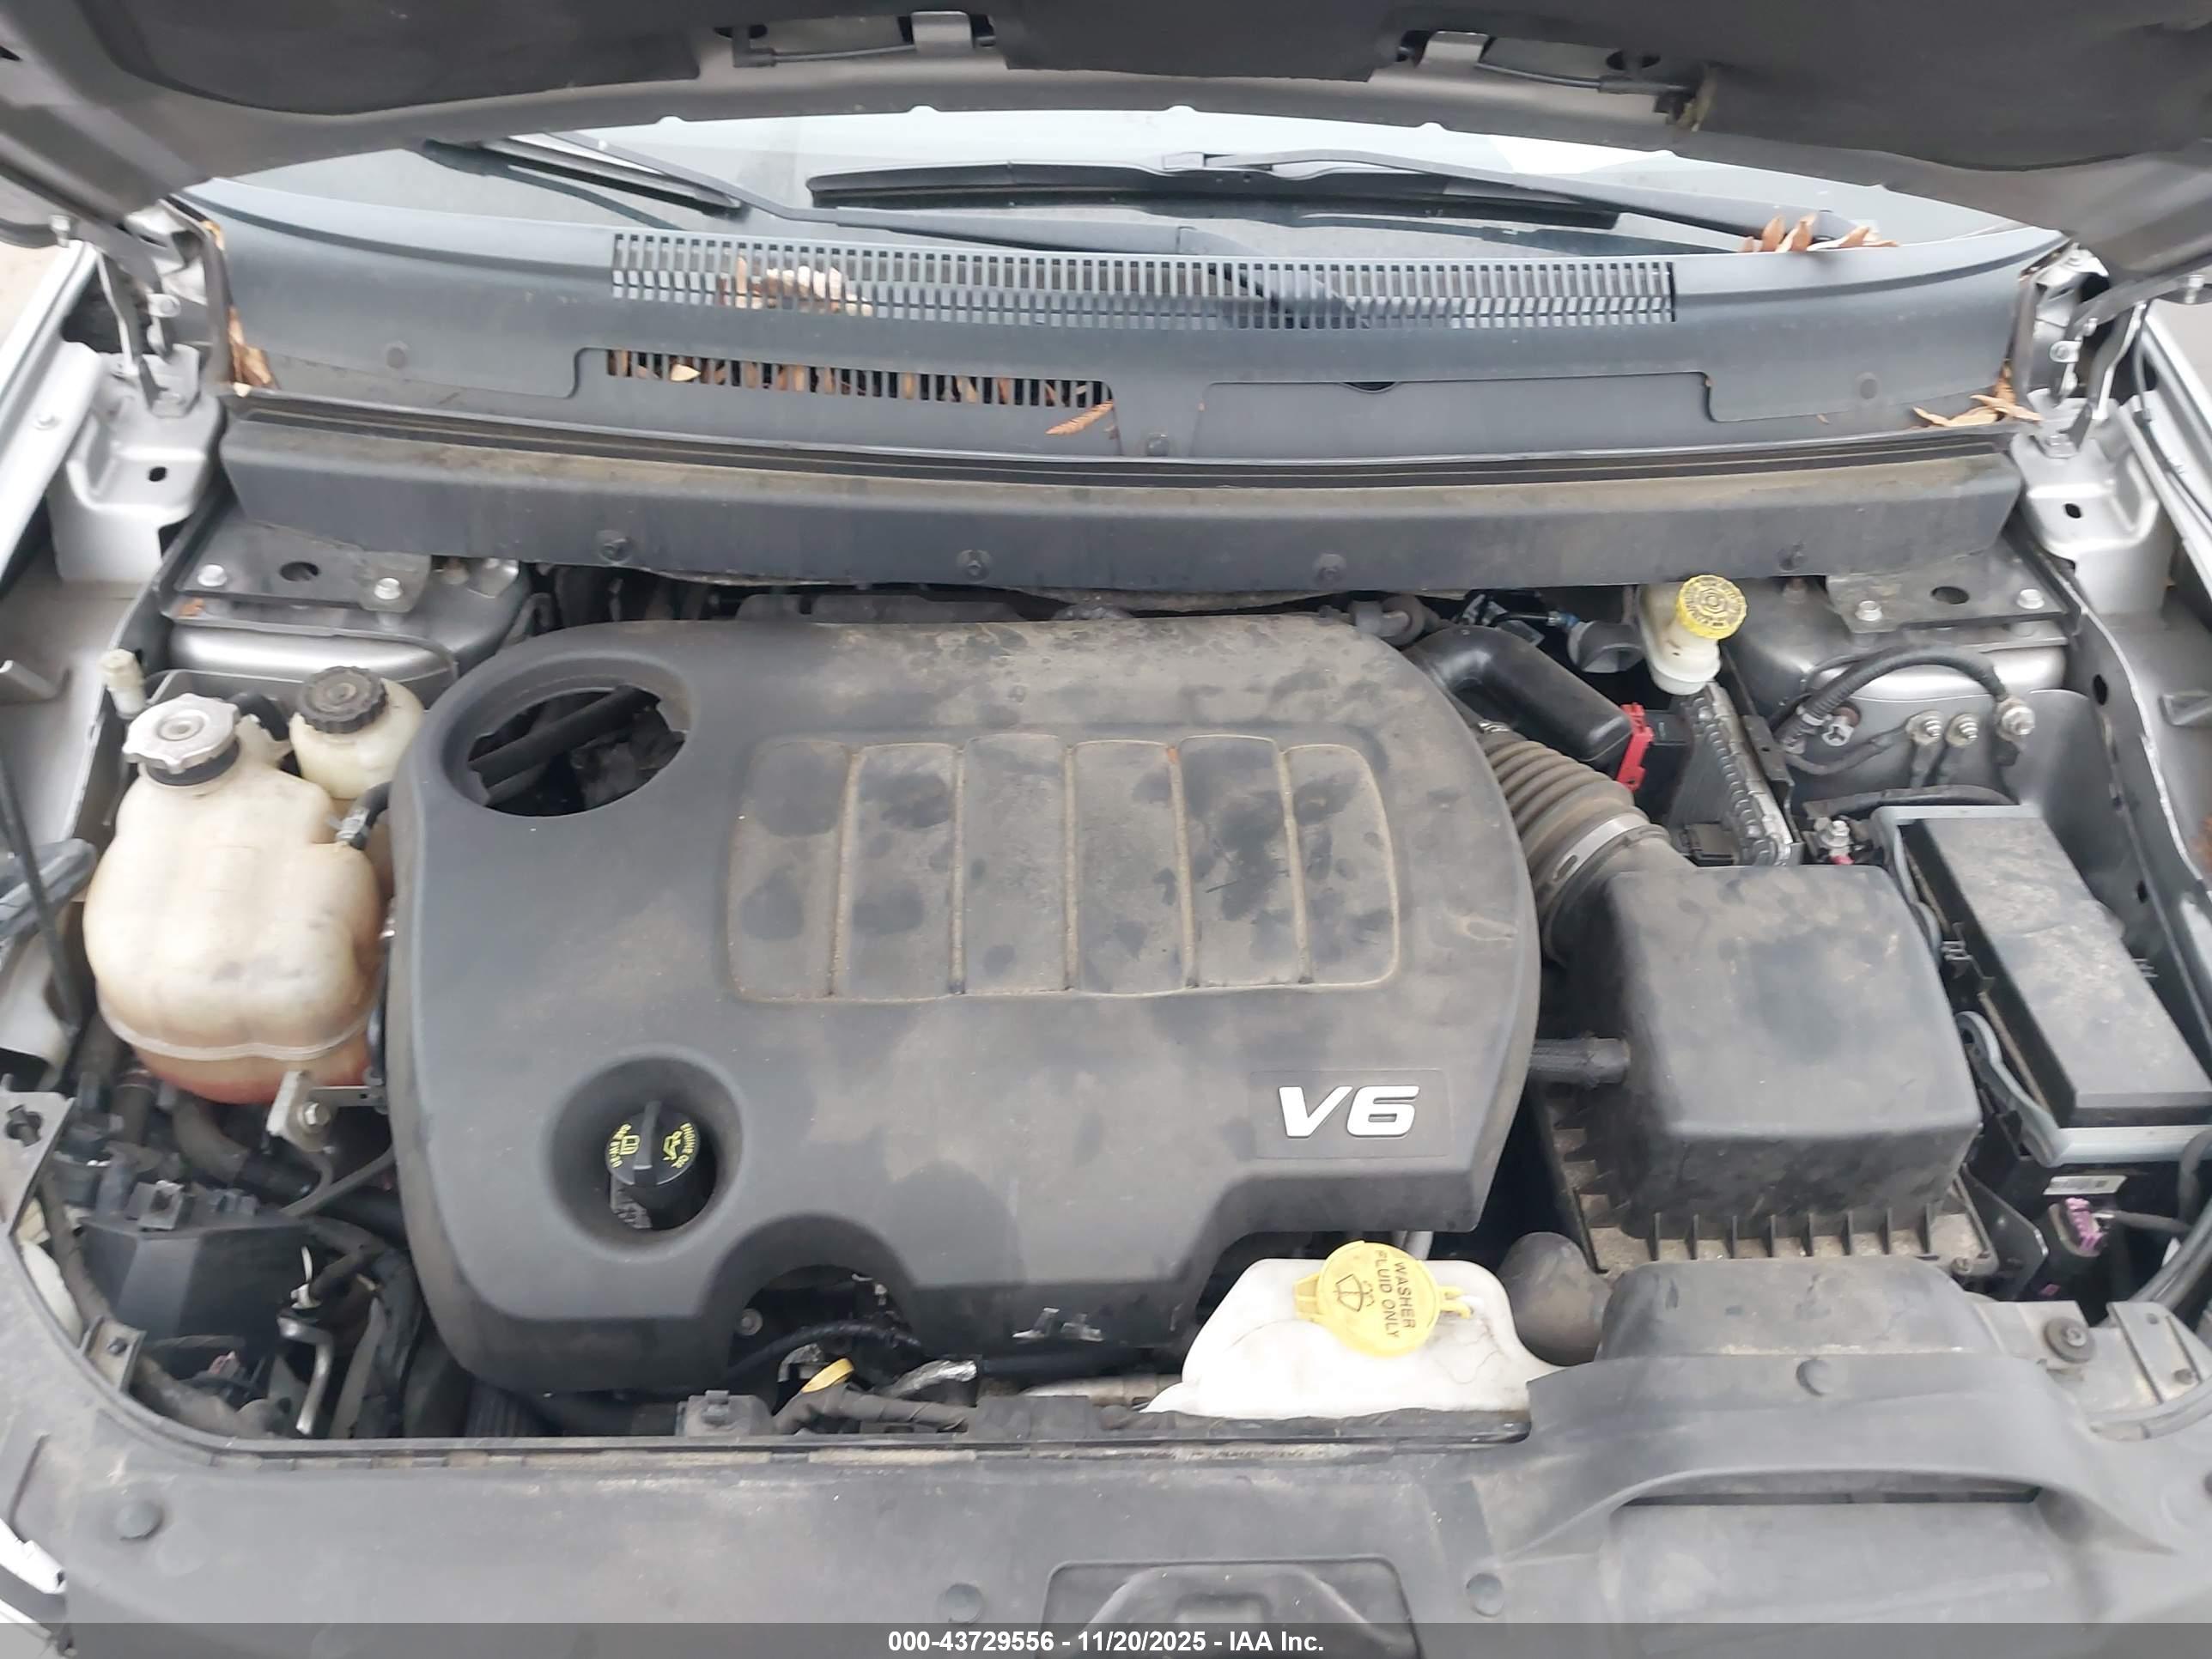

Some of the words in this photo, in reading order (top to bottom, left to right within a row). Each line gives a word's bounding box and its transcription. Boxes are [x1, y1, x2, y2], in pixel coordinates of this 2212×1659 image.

[1278, 1085, 1420, 1138] V6
[680, 1122, 696, 1154] ENGINE
[671, 1154, 690, 1169] OIL
[1375, 1249, 1393, 1293] FLUID
[1394, 1261, 1416, 1328] WASHER
[1381, 1298, 1401, 1338] ONLY
